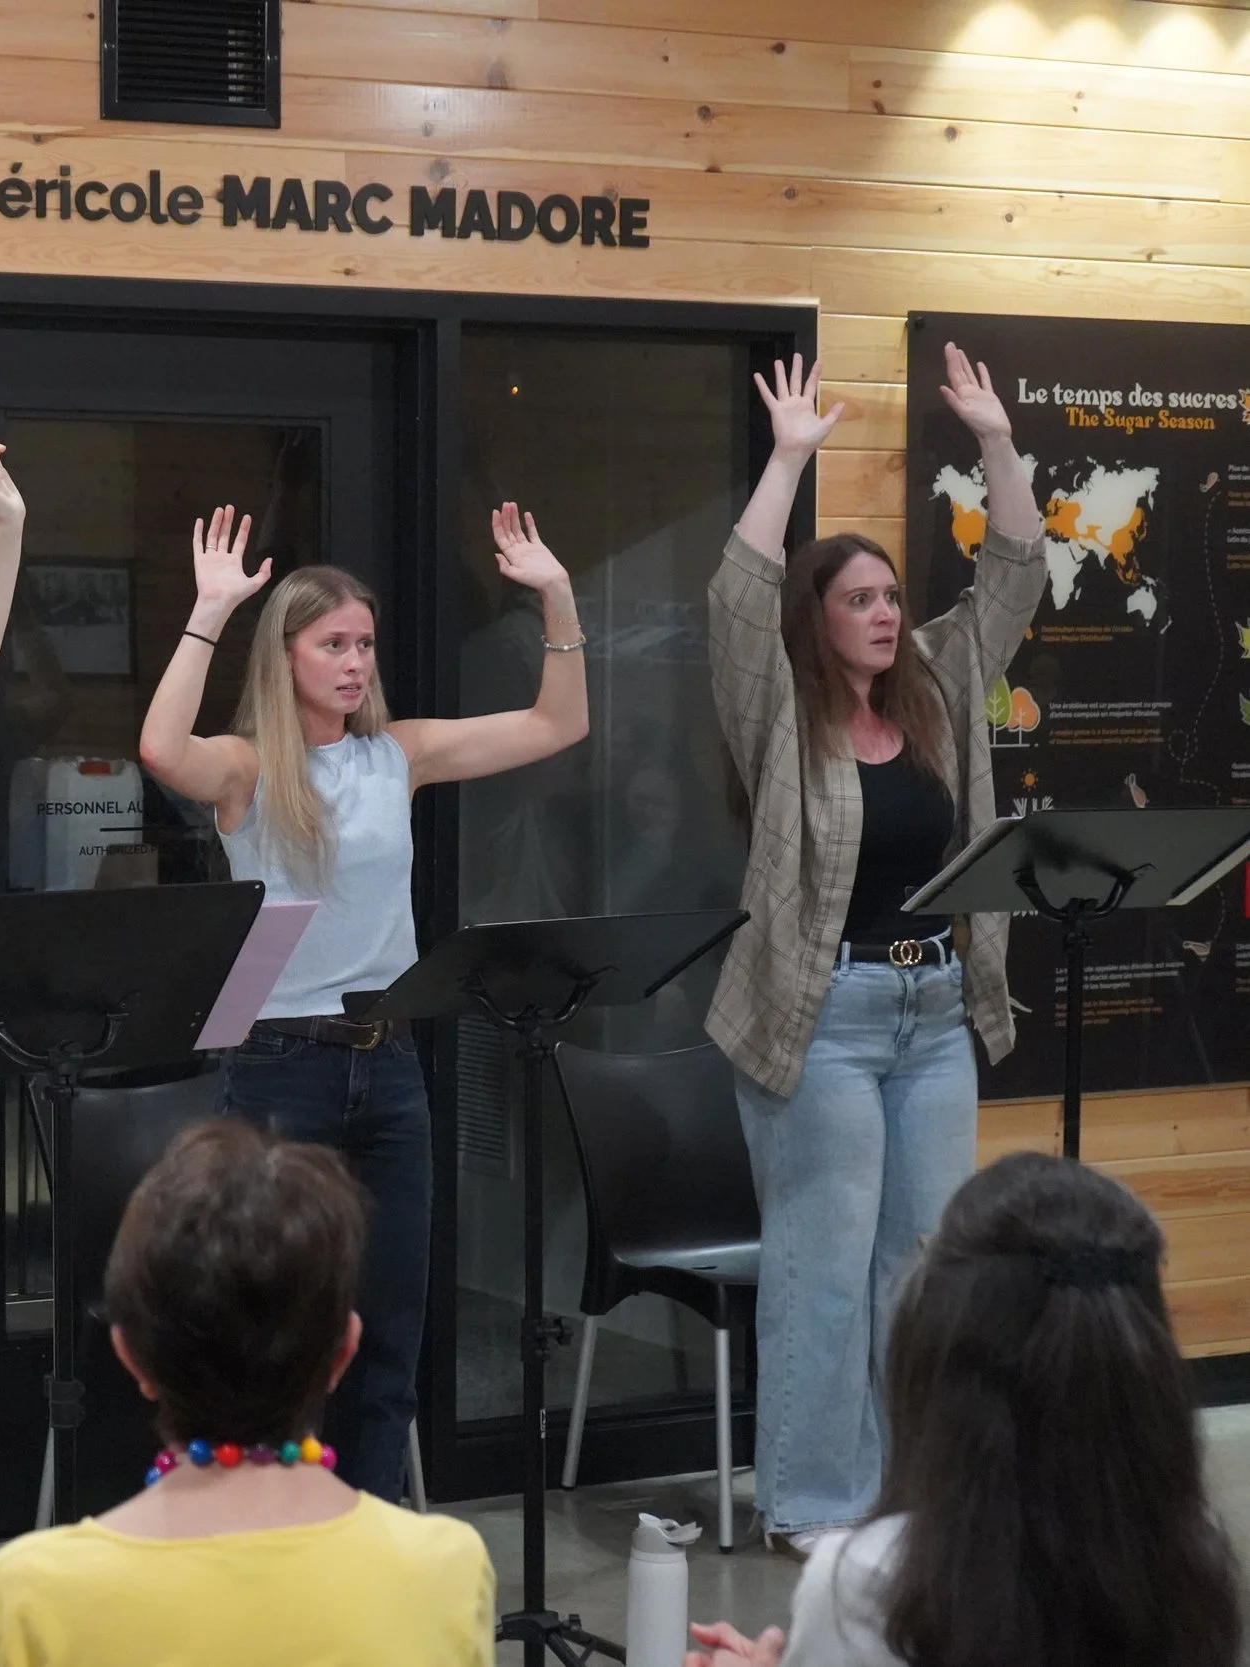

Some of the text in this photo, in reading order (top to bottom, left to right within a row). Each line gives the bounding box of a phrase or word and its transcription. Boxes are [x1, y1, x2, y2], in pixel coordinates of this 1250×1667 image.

[222, 174, 394, 234] MARC
[410, 185, 650, 248] MADORE
[1018, 378, 1238, 414] Le temps des sucres
[1065, 407, 1215, 435] The Sugar Season
[37, 800, 123, 816] PERSONNEL
[78, 844, 148, 856] AUTHORIZED
